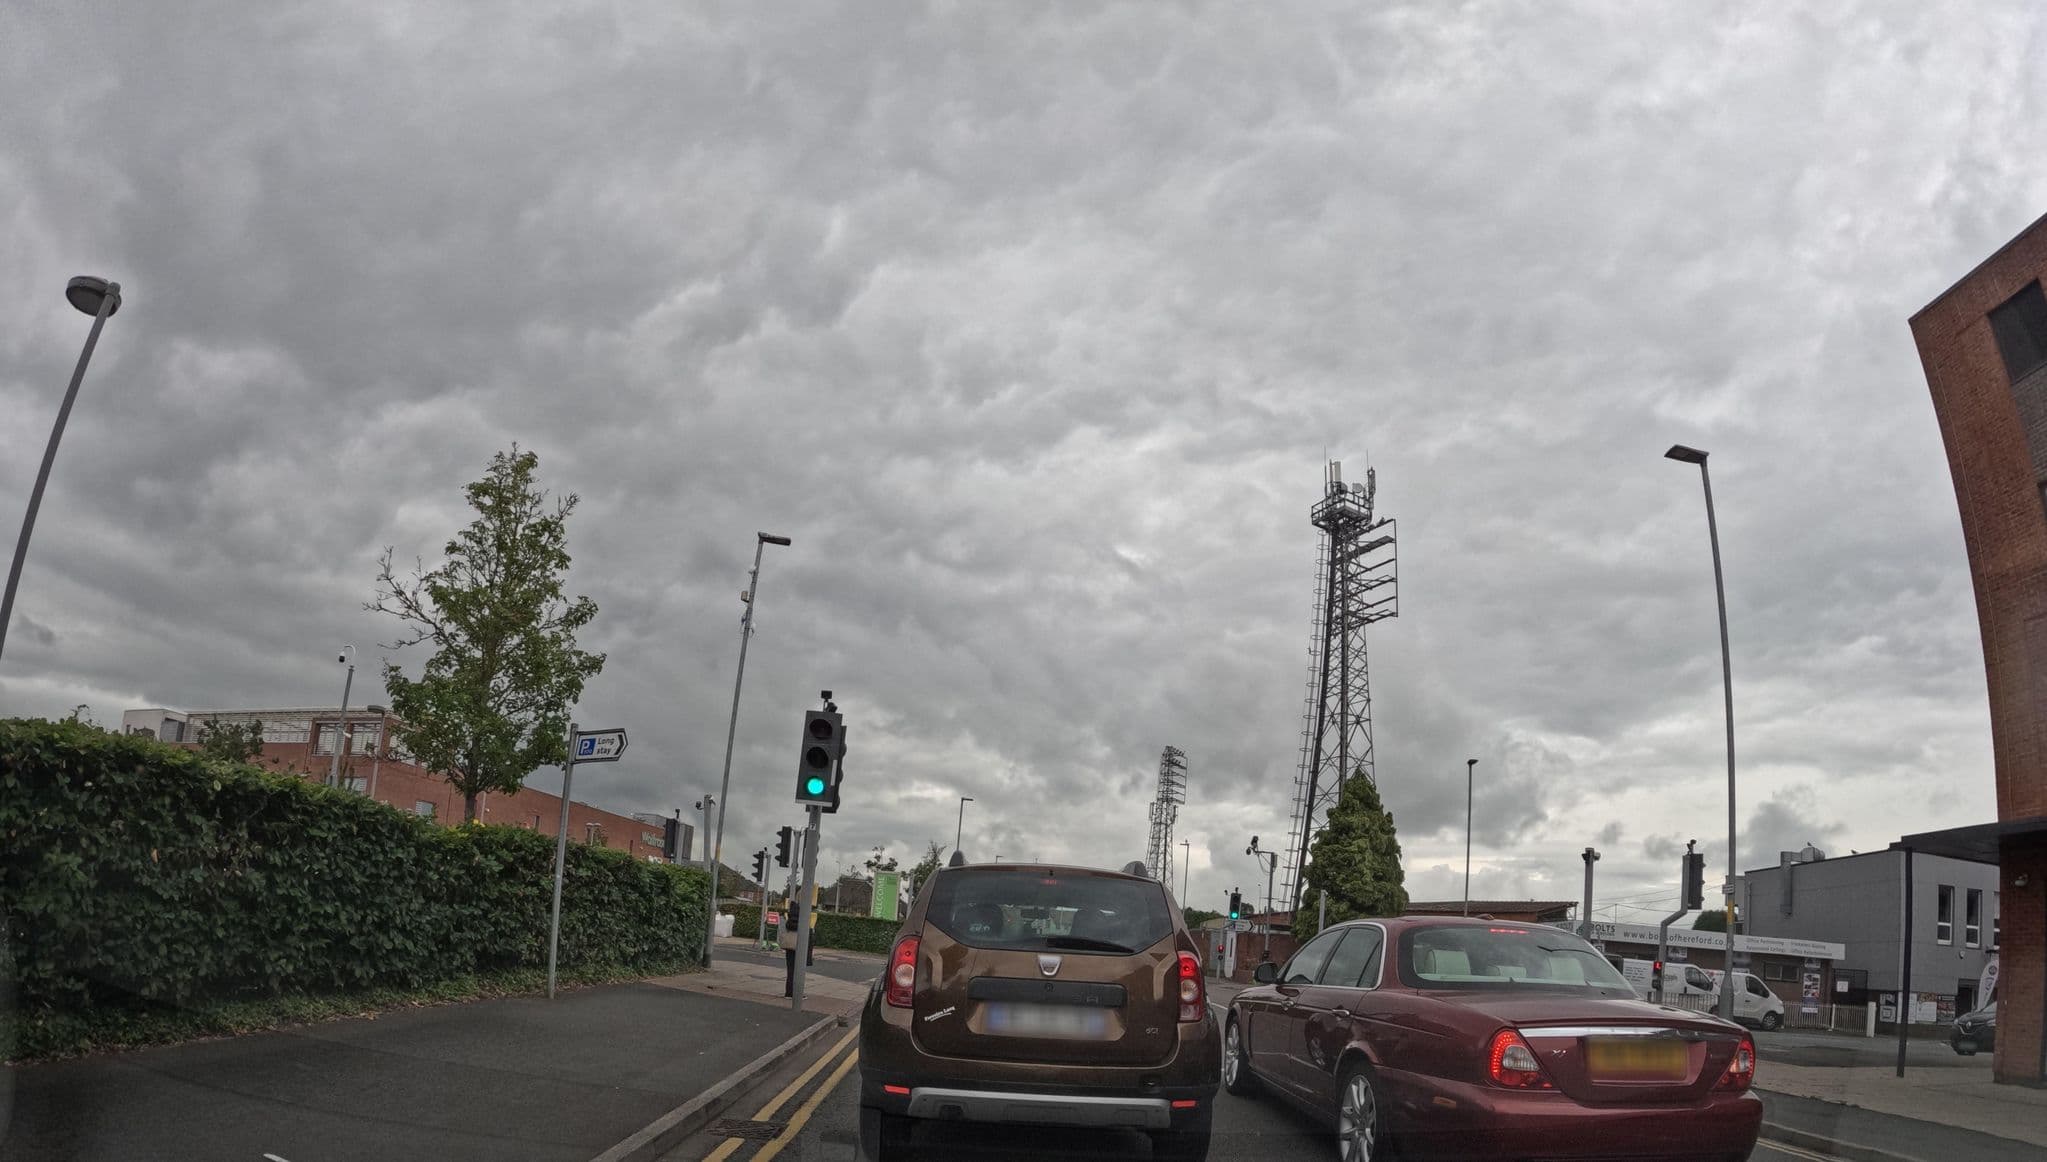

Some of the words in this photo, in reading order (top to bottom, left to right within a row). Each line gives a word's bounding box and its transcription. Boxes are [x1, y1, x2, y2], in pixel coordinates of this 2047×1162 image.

[597, 737, 615, 746] Long
[580, 740, 590, 755] P
[596, 747, 611, 756] stay
